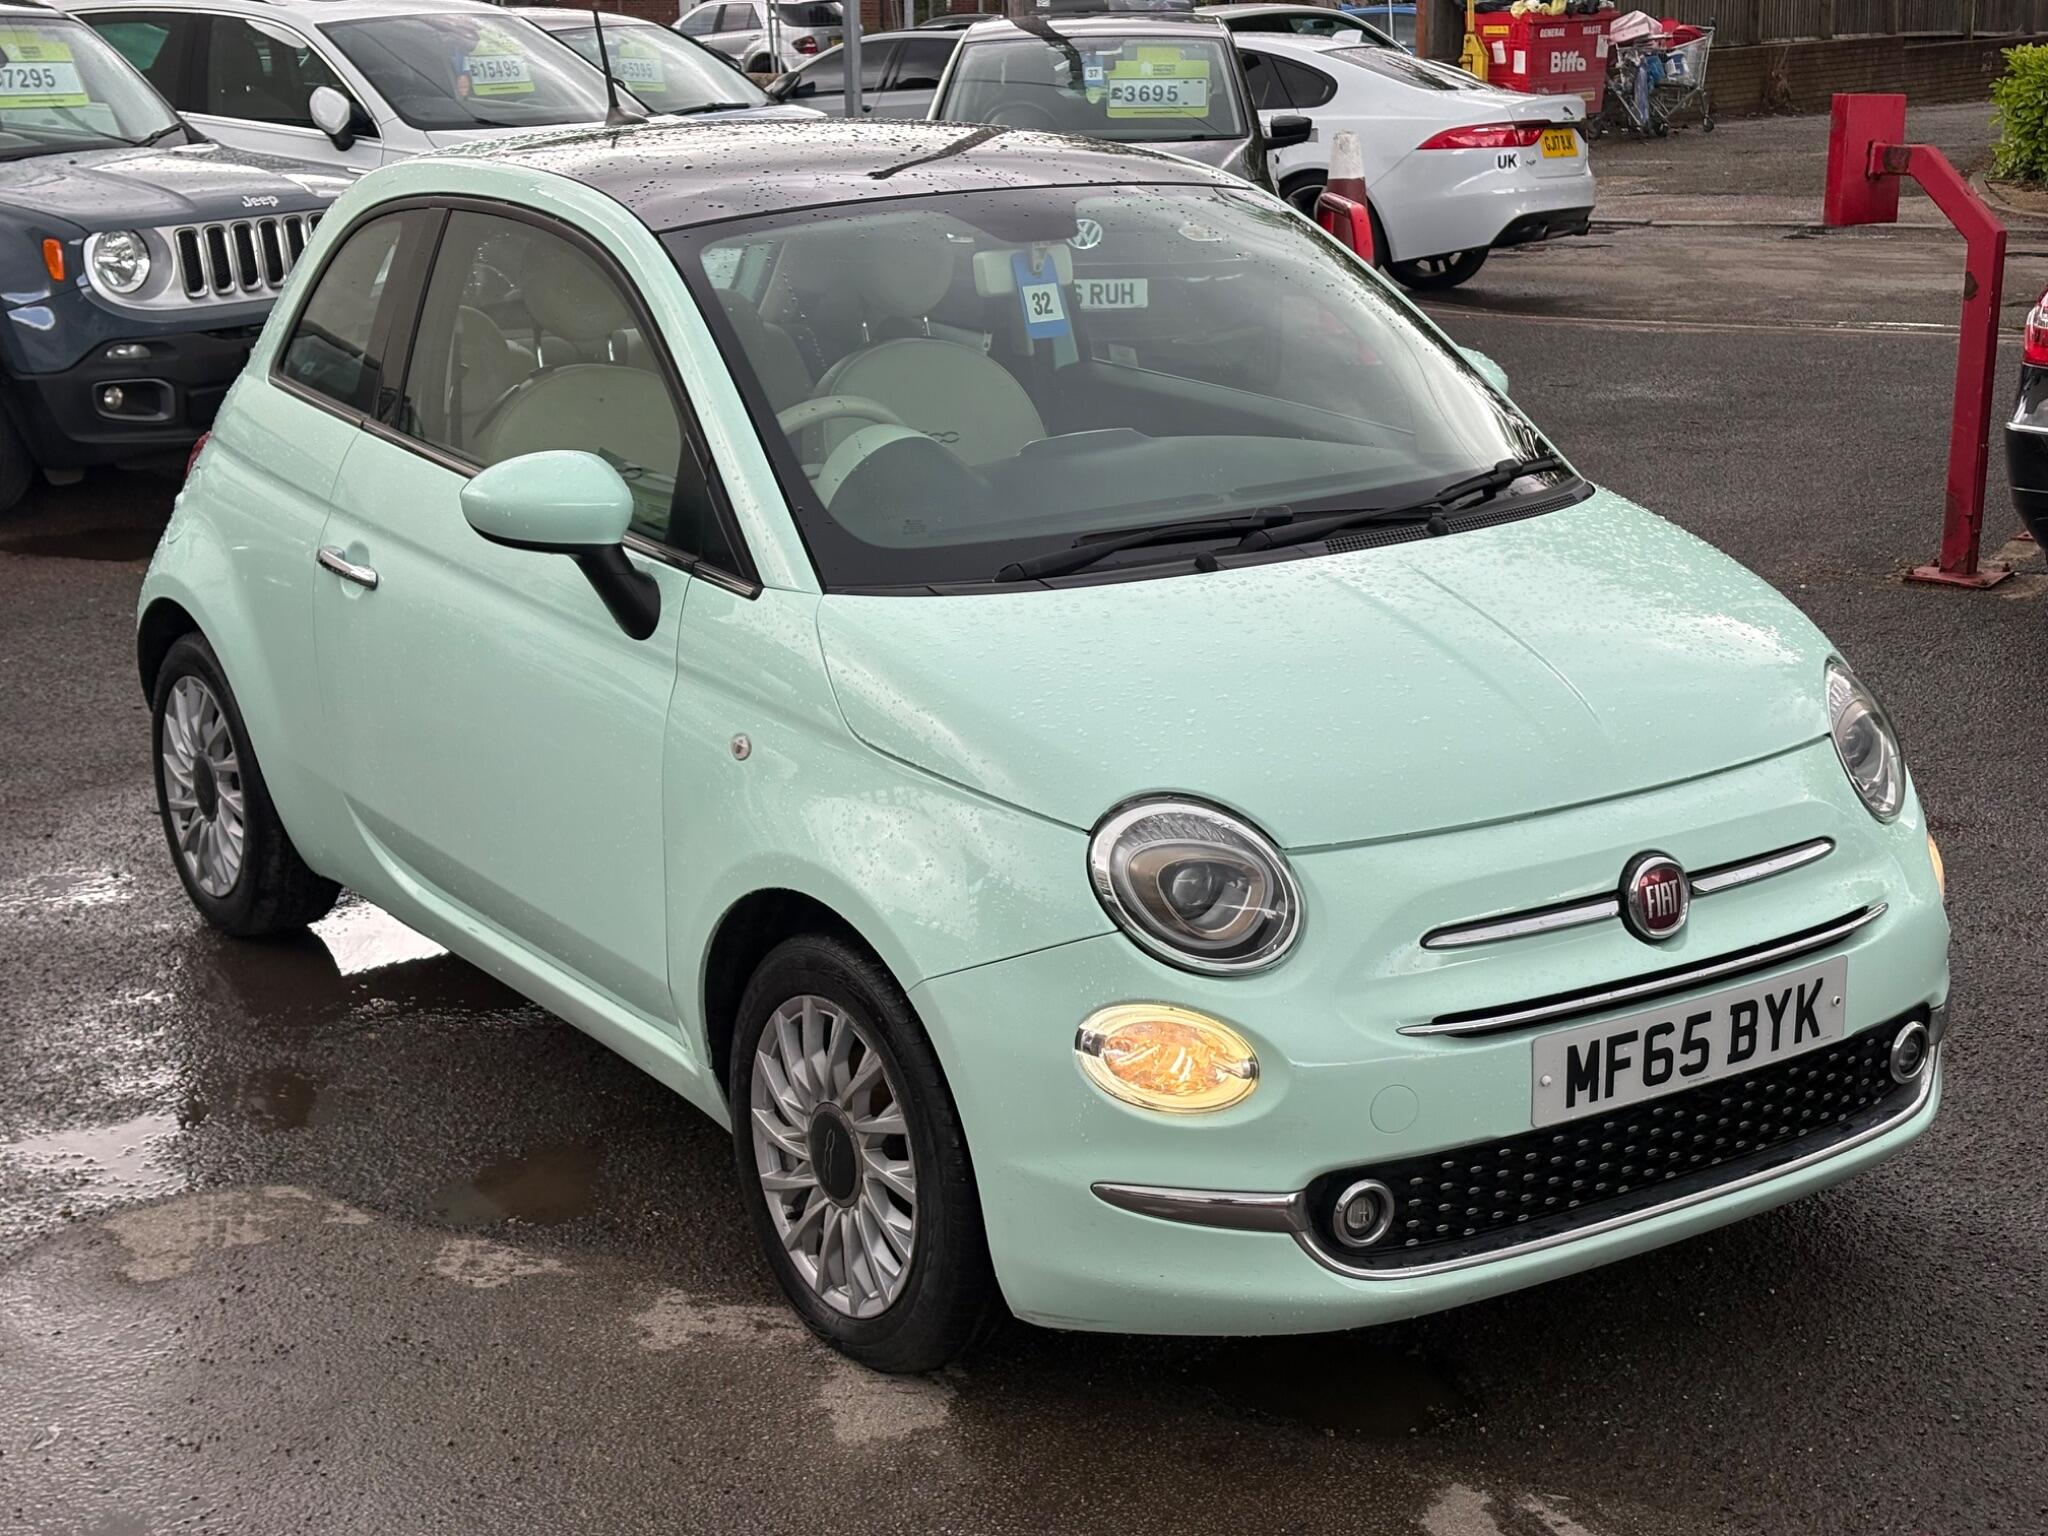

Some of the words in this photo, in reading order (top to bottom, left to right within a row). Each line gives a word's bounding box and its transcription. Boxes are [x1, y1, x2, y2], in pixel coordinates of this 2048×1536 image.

[1540, 28, 1565, 38] GENERAL
[1583, 25, 1602, 35] WASTE
[1550, 50, 1587, 73] Biffa
[1087, 69, 1099, 78] 37
[1110, 85, 1179, 102] £3695
[1497, 154, 1517, 169] UK
[242, 195, 279, 207] Jeep
[1032, 291, 1053, 315] 32
[1090, 283, 1134, 305] RUH
[1645, 879, 1678, 919] FIAT
[1566, 1010, 1712, 1109] MF65
[1727, 977, 1824, 1065] BYK
